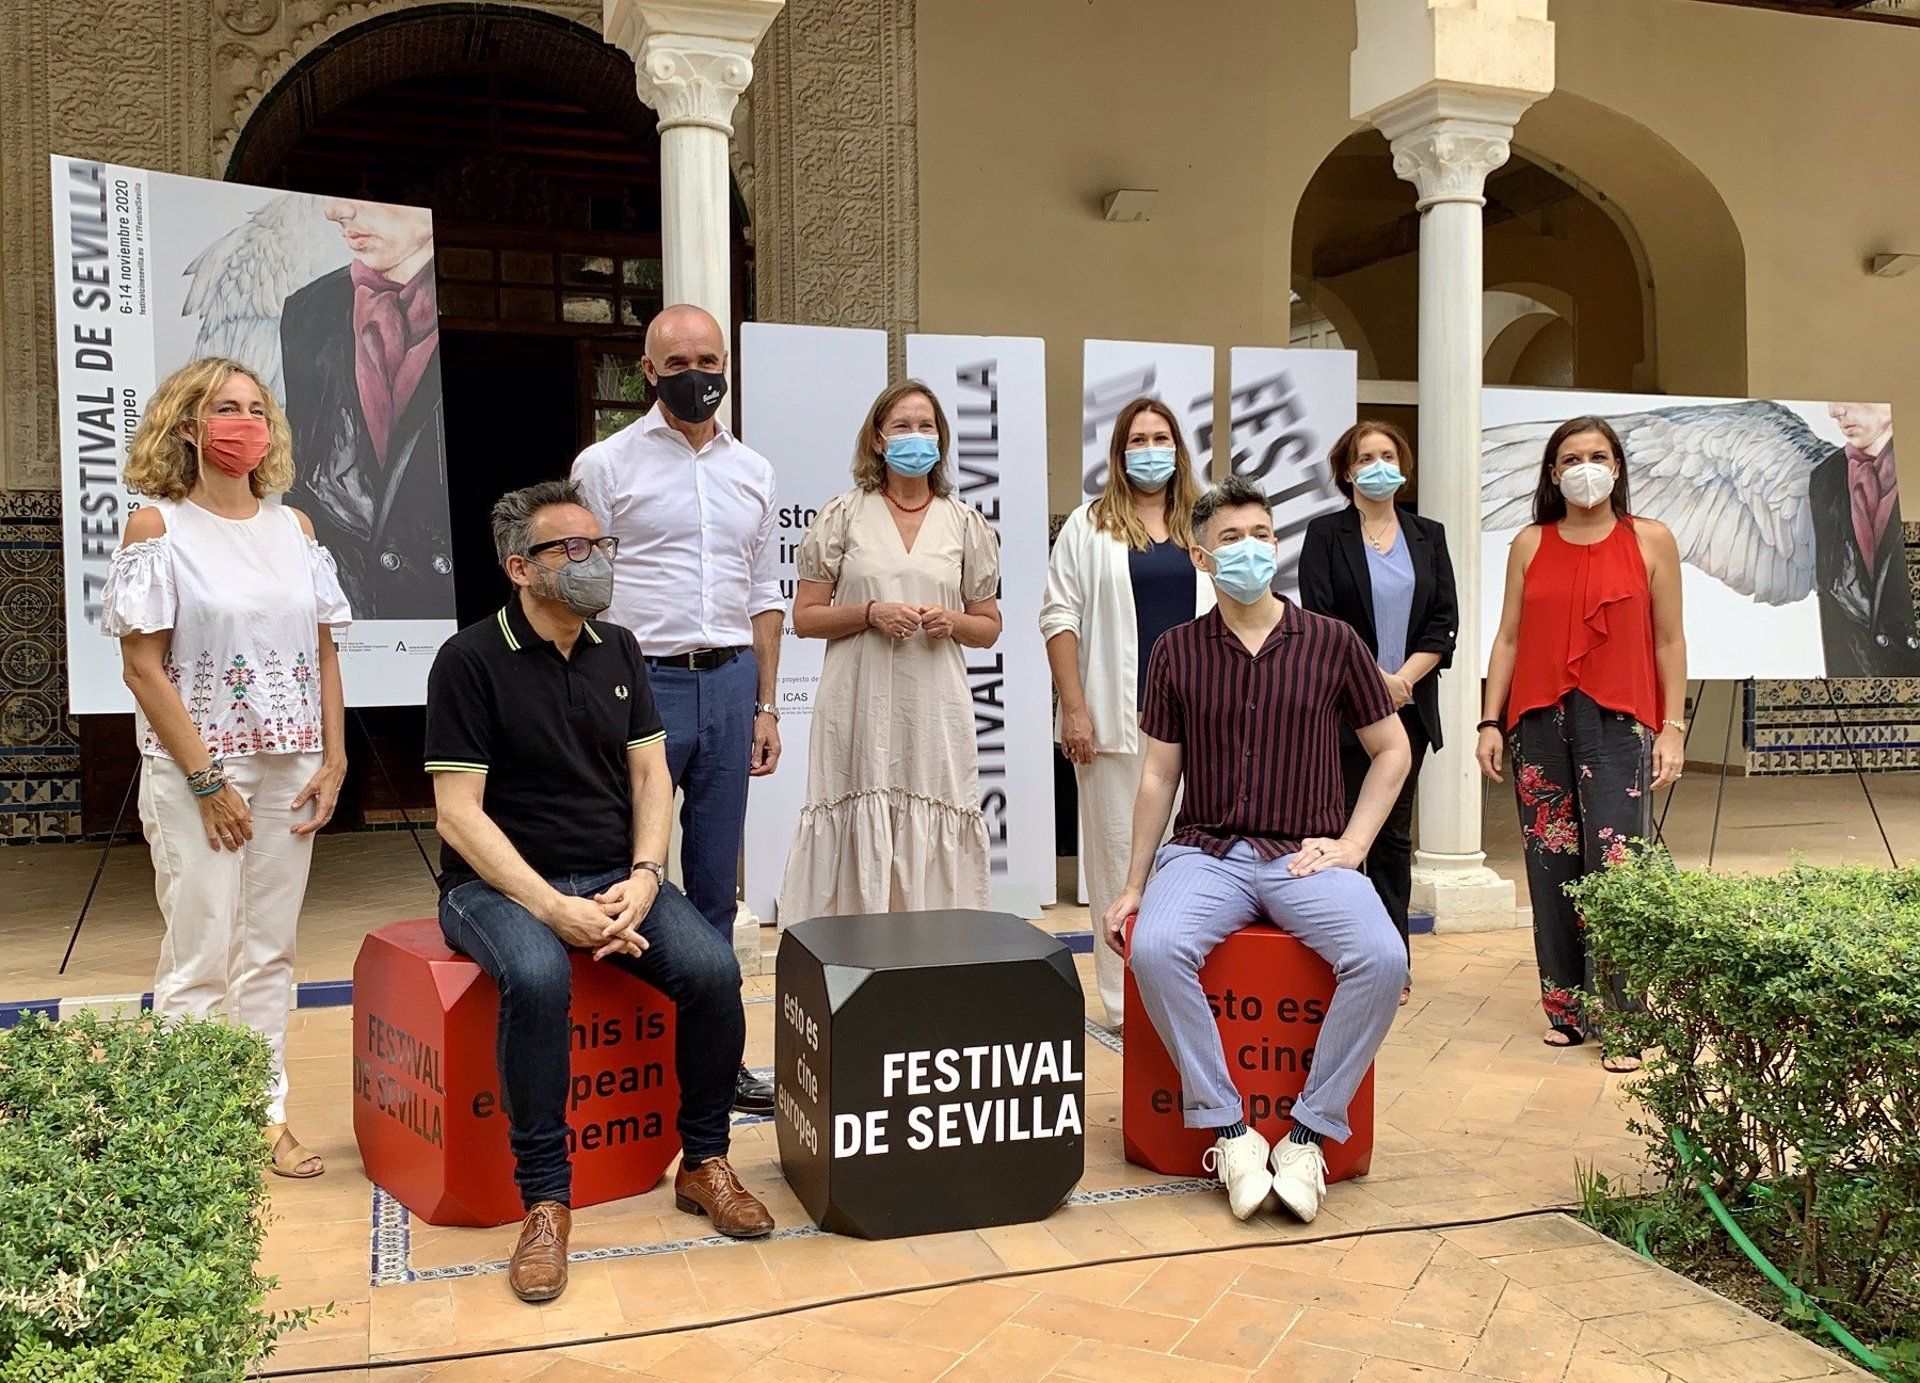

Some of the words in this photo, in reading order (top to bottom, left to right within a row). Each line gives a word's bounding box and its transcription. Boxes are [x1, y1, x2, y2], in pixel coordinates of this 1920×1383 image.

[115, 180, 130, 214] 2020
[69, 162, 110, 313] SEVILLA
[116, 217, 132, 283] noviembre
[119, 285, 133, 315] 6-14
[74, 324, 114, 372] DE
[76, 386, 119, 562] FESTIVAL
[956, 358, 1002, 548] EVILLA
[783, 692, 809, 702] ICAS
[570, 1013, 623, 1052] his
[635, 1006, 666, 1042] is
[784, 992, 804, 1036] esto
[805, 1015, 819, 1052] es
[1209, 989, 1263, 1024] sto
[1277, 995, 1325, 1024] es
[368, 1013, 445, 1097] FESTIVAL
[797, 1053, 819, 1104] cine
[883, 1039, 1083, 1098] FESTIVAL
[353, 1055, 372, 1101] DE
[377, 1069, 445, 1150] SEVILLA
[472, 1061, 664, 1119] epean
[778, 1084, 818, 1157] europeo
[834, 1110, 890, 1159] DE
[907, 1093, 1082, 1152] SEVILLA
